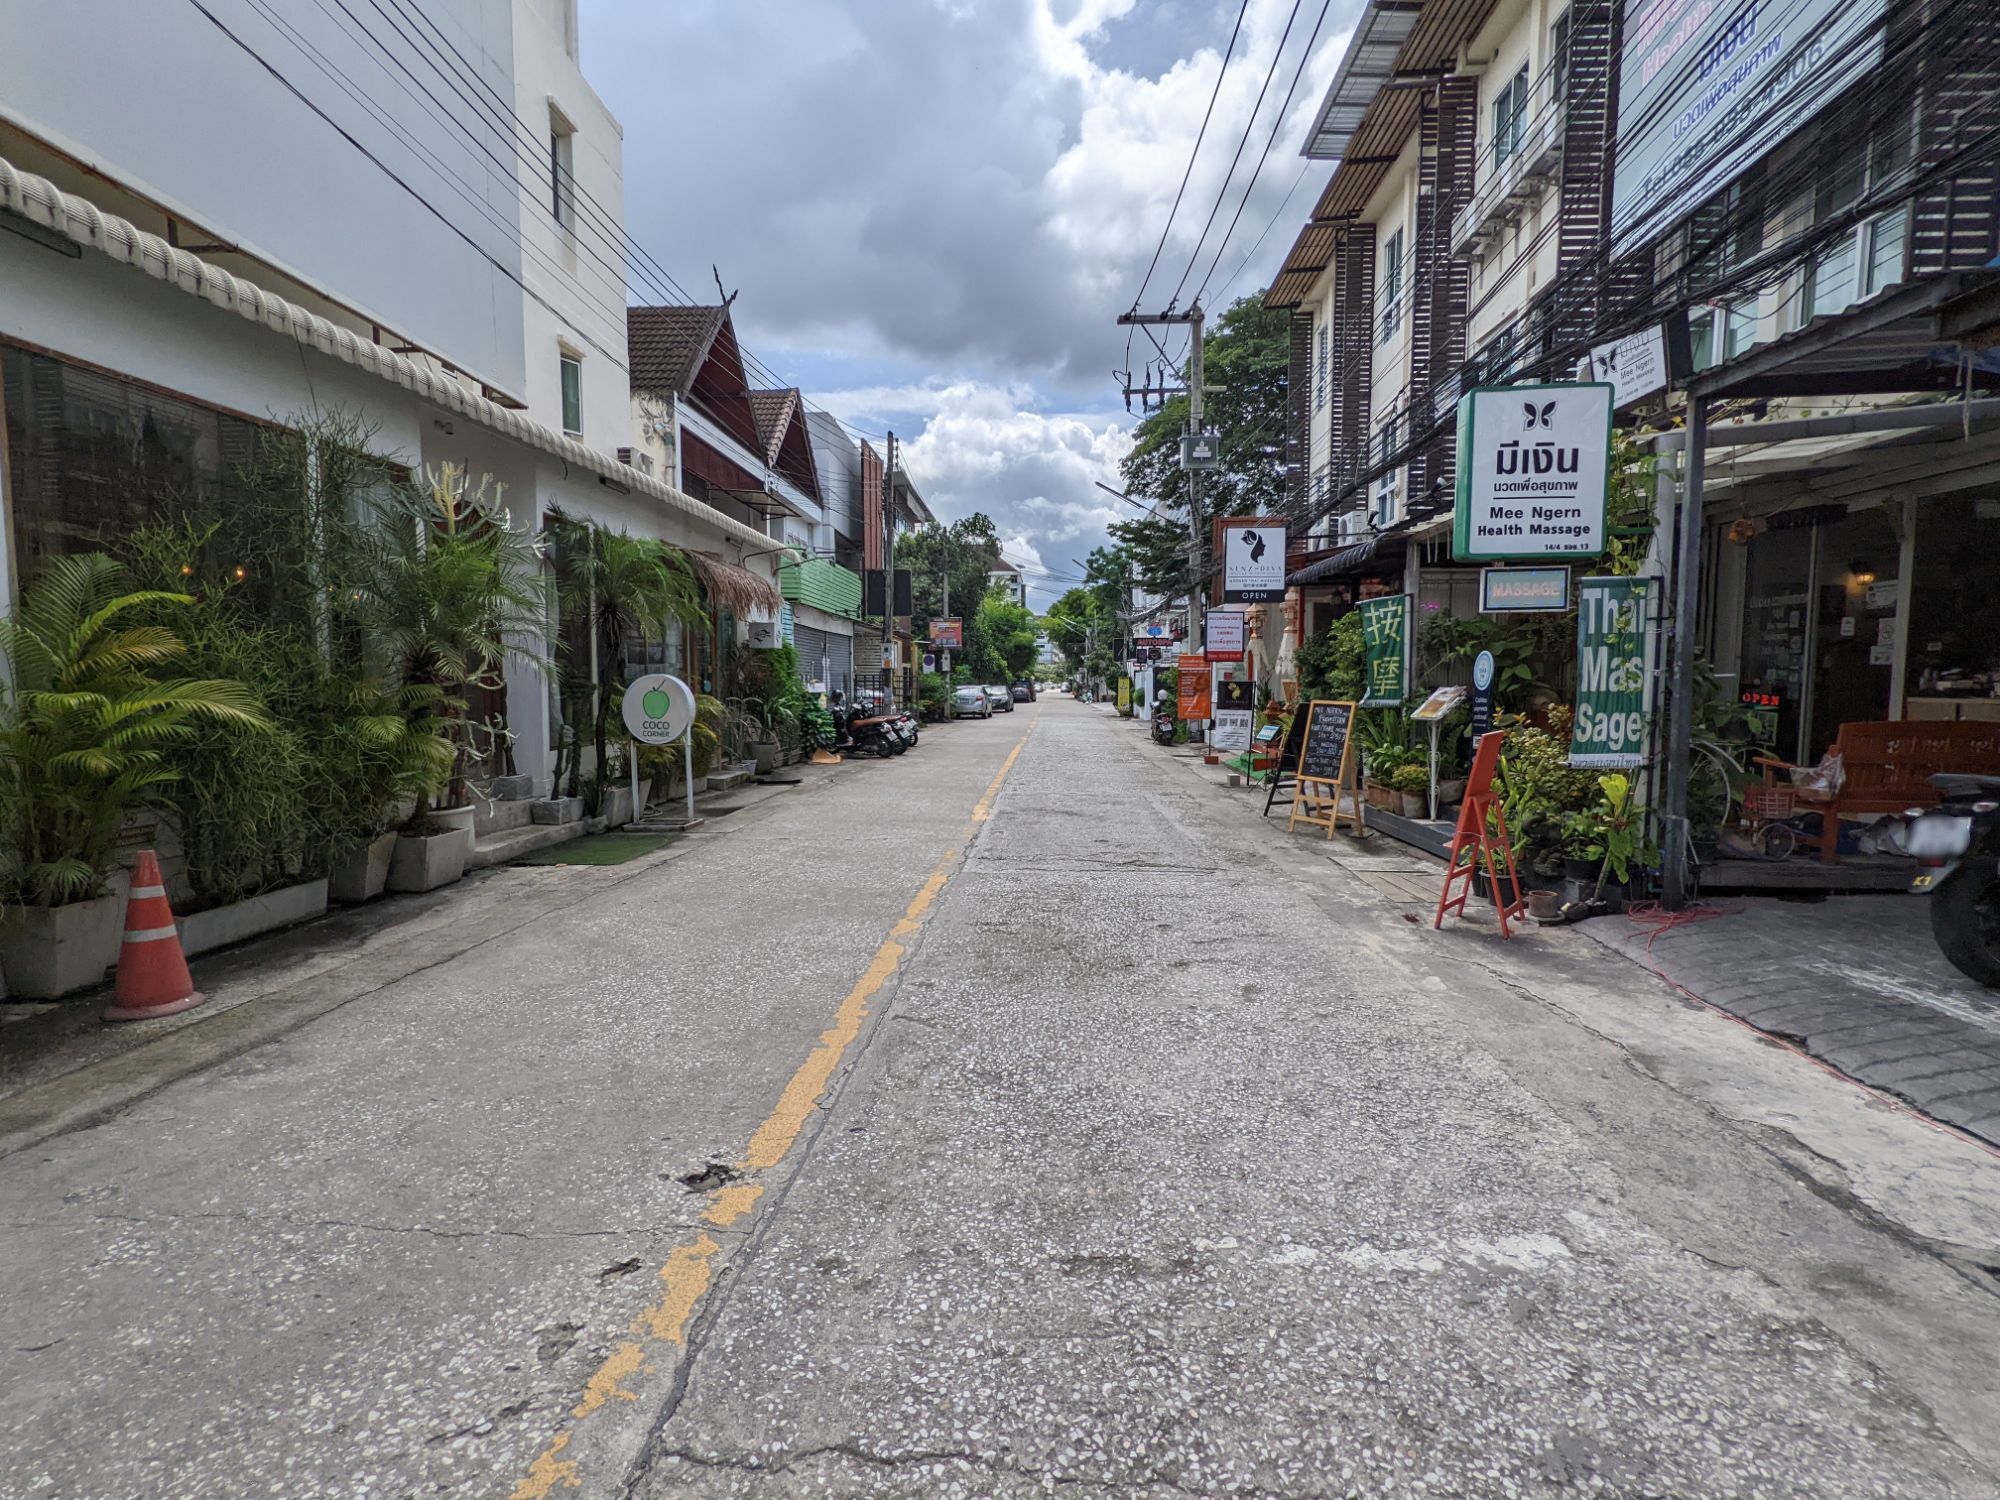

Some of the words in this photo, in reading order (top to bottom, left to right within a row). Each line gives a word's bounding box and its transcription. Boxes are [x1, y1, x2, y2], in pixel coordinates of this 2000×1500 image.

[1496, 440, 1579, 475] มีเงิน
[1494, 477, 1578, 494] นวดเพื่อสุขภาพ
[1489, 507, 1524, 519] Mee
[1532, 507, 1581, 521] Ngern
[1478, 524, 1523, 536] Health
[1529, 524, 1590, 537] Massage
[1492, 581, 1560, 599] MASSAGE
[1582, 587, 1646, 634] Thai
[1581, 646, 1644, 692] Mas
[1742, 692, 1780, 706] OPEN
[643, 721, 670, 729] COCO
[1575, 702, 1642, 751] Sage
[1912, 876, 1932, 886] K1
